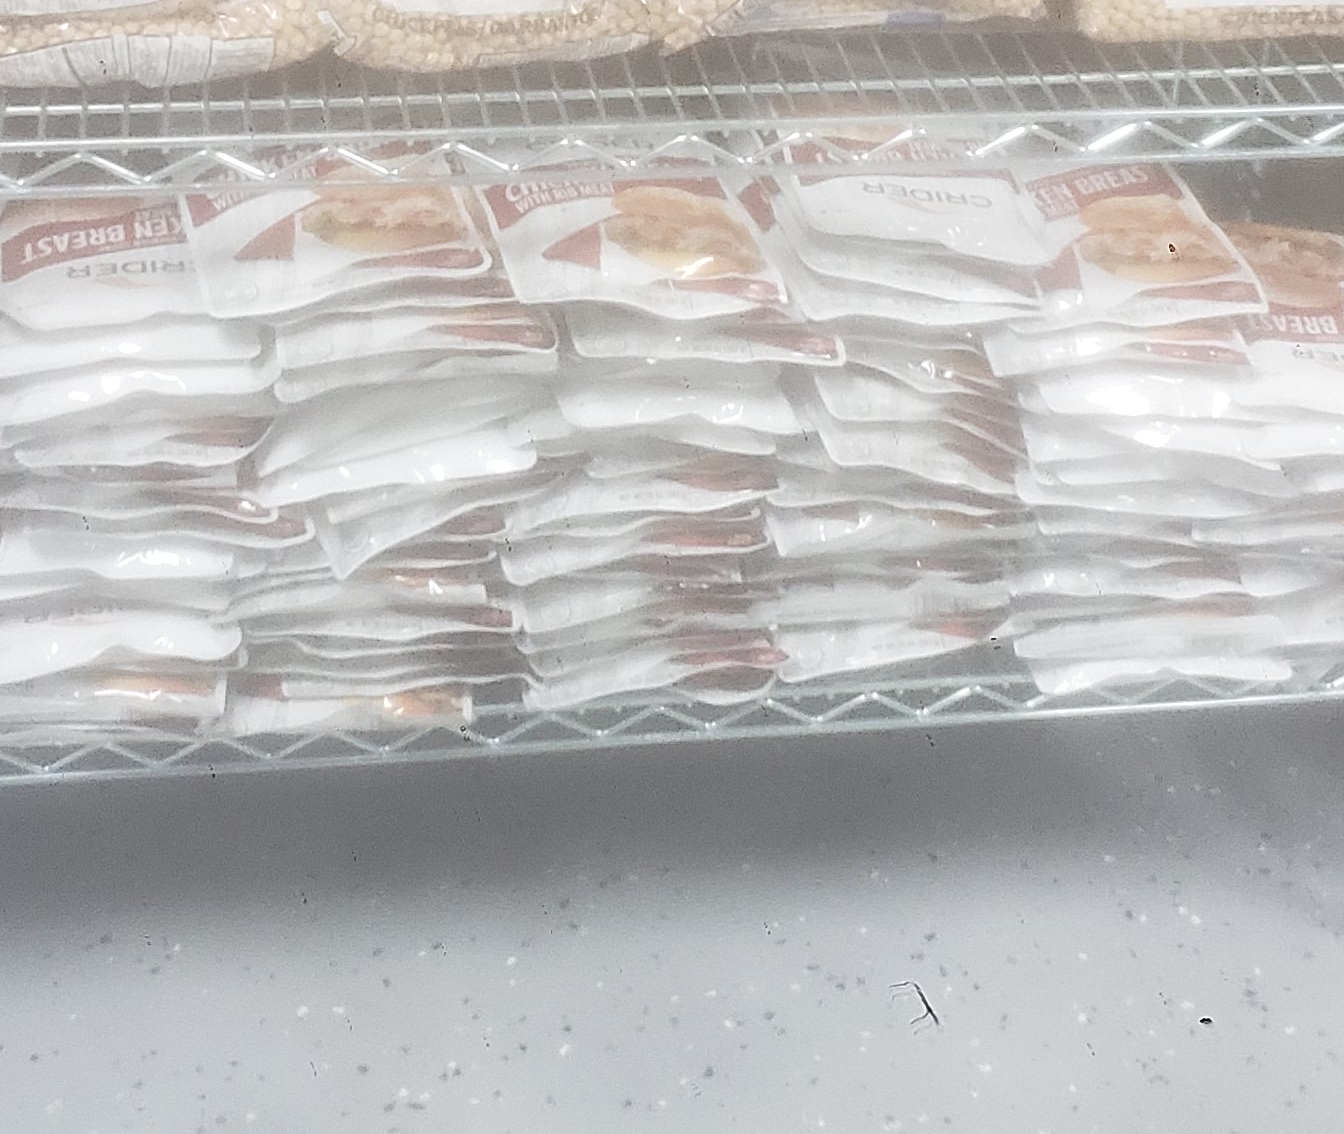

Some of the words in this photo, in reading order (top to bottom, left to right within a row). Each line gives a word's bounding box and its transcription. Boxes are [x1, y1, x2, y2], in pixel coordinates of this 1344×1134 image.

[862, 181, 994, 209] CRIDER
[1073, 165, 1149, 196] BREAS
[20, 223, 126, 265] BREAST
